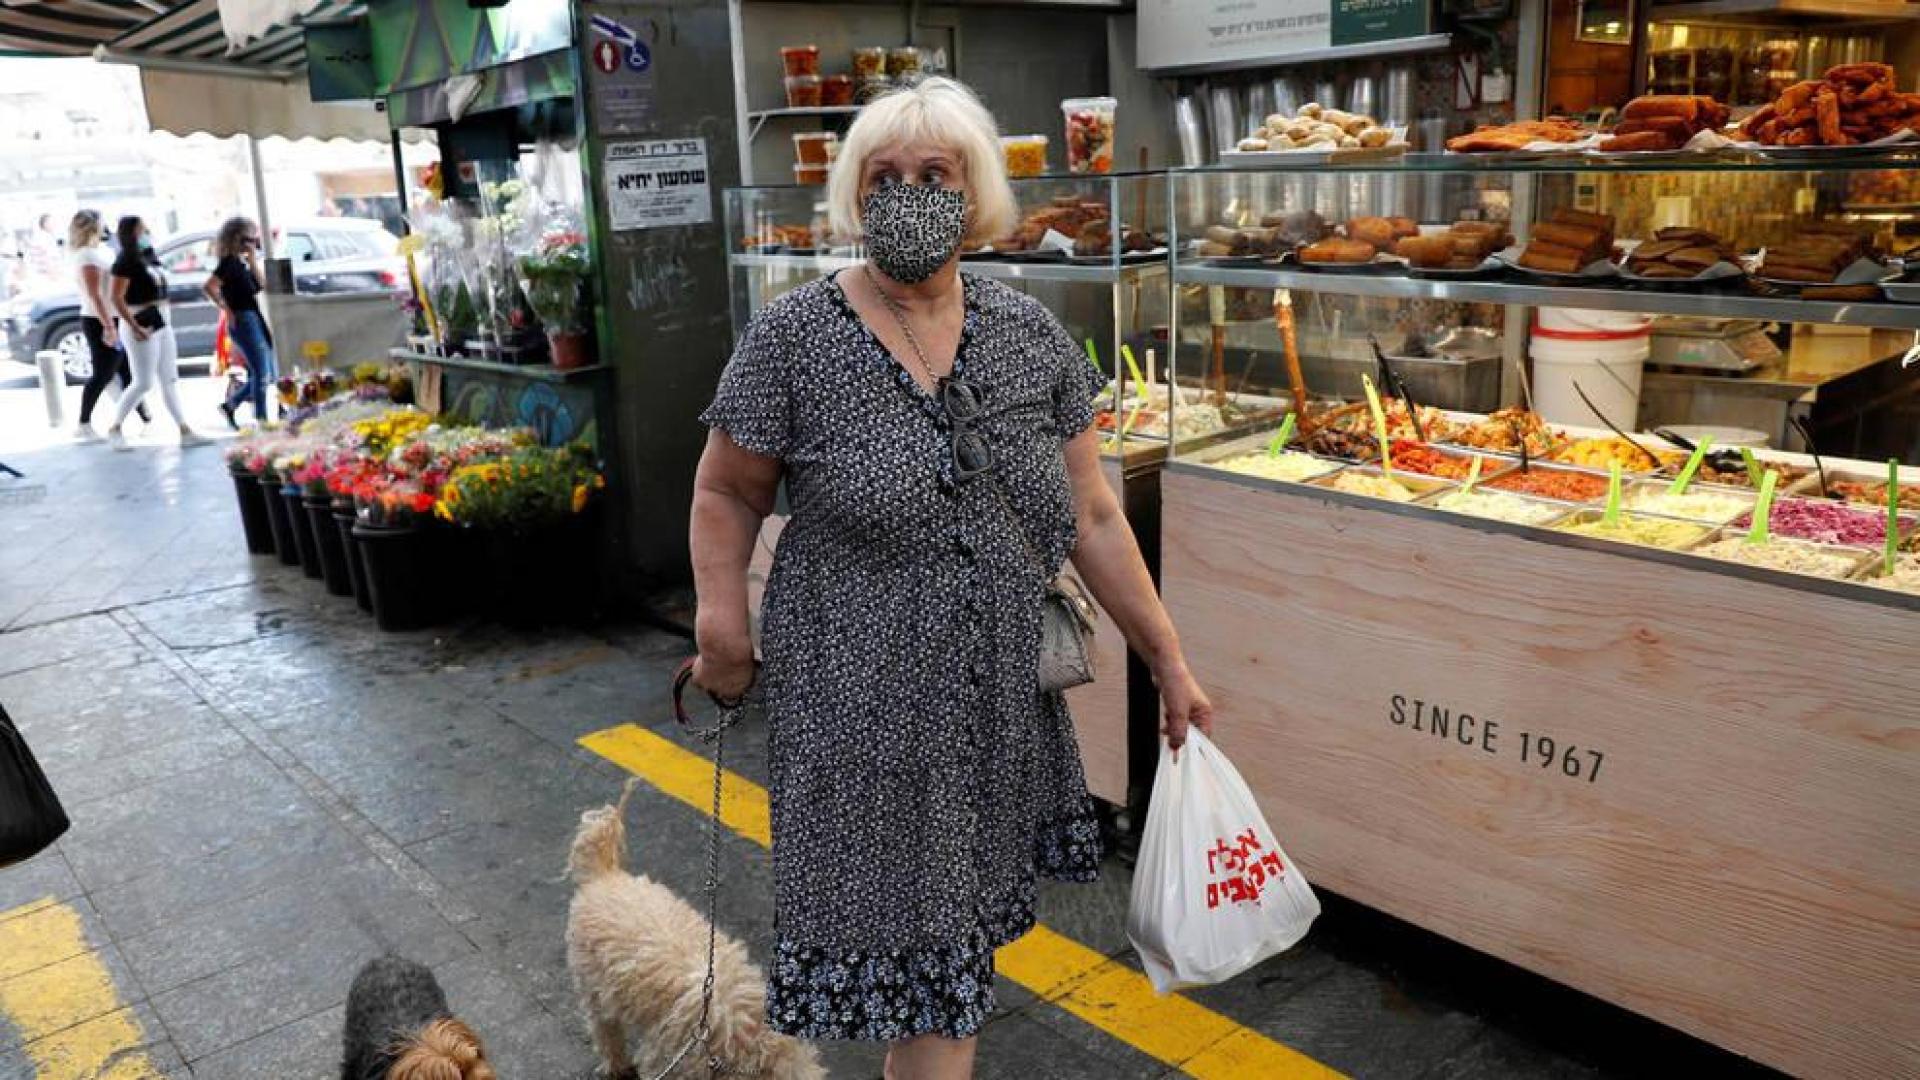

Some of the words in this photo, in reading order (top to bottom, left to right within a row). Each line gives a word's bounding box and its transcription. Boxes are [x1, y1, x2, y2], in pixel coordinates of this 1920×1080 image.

[618, 172, 652, 190] יחיא
[657, 169, 705, 189] שמשון
[1390, 694, 1499, 753] SINCE
[1519, 732, 1605, 783] 1967
